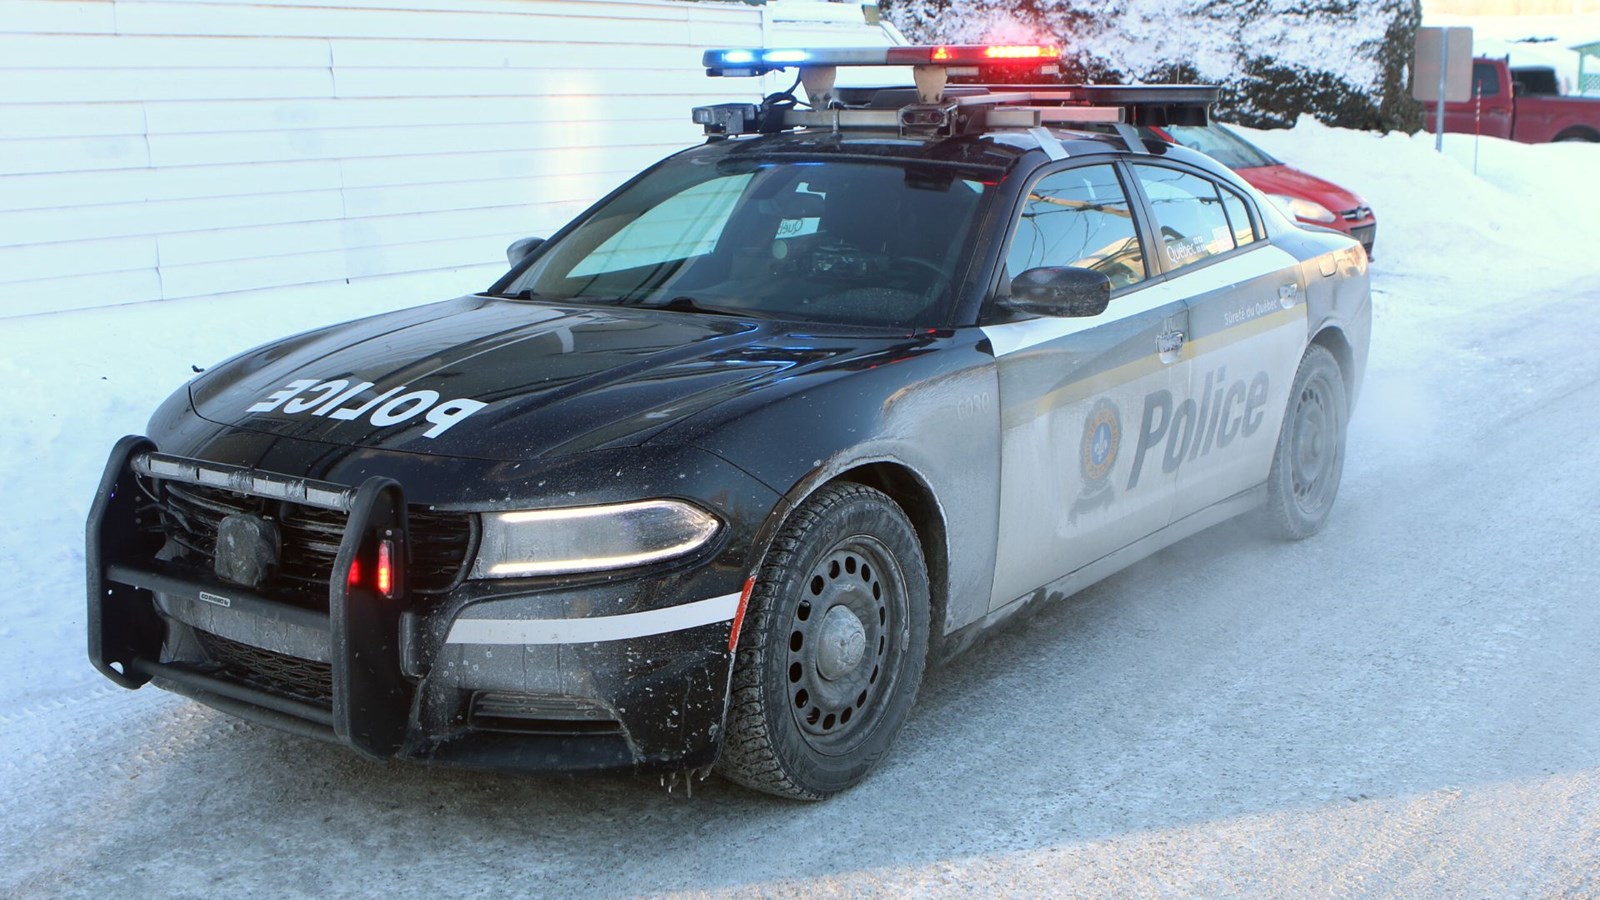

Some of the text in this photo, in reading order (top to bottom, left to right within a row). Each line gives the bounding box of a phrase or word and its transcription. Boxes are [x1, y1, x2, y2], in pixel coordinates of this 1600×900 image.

[1166, 241, 1197, 264] Québec
[1224, 299, 1278, 325] Sûreté du Québec
[1126, 366, 1270, 491] Police
